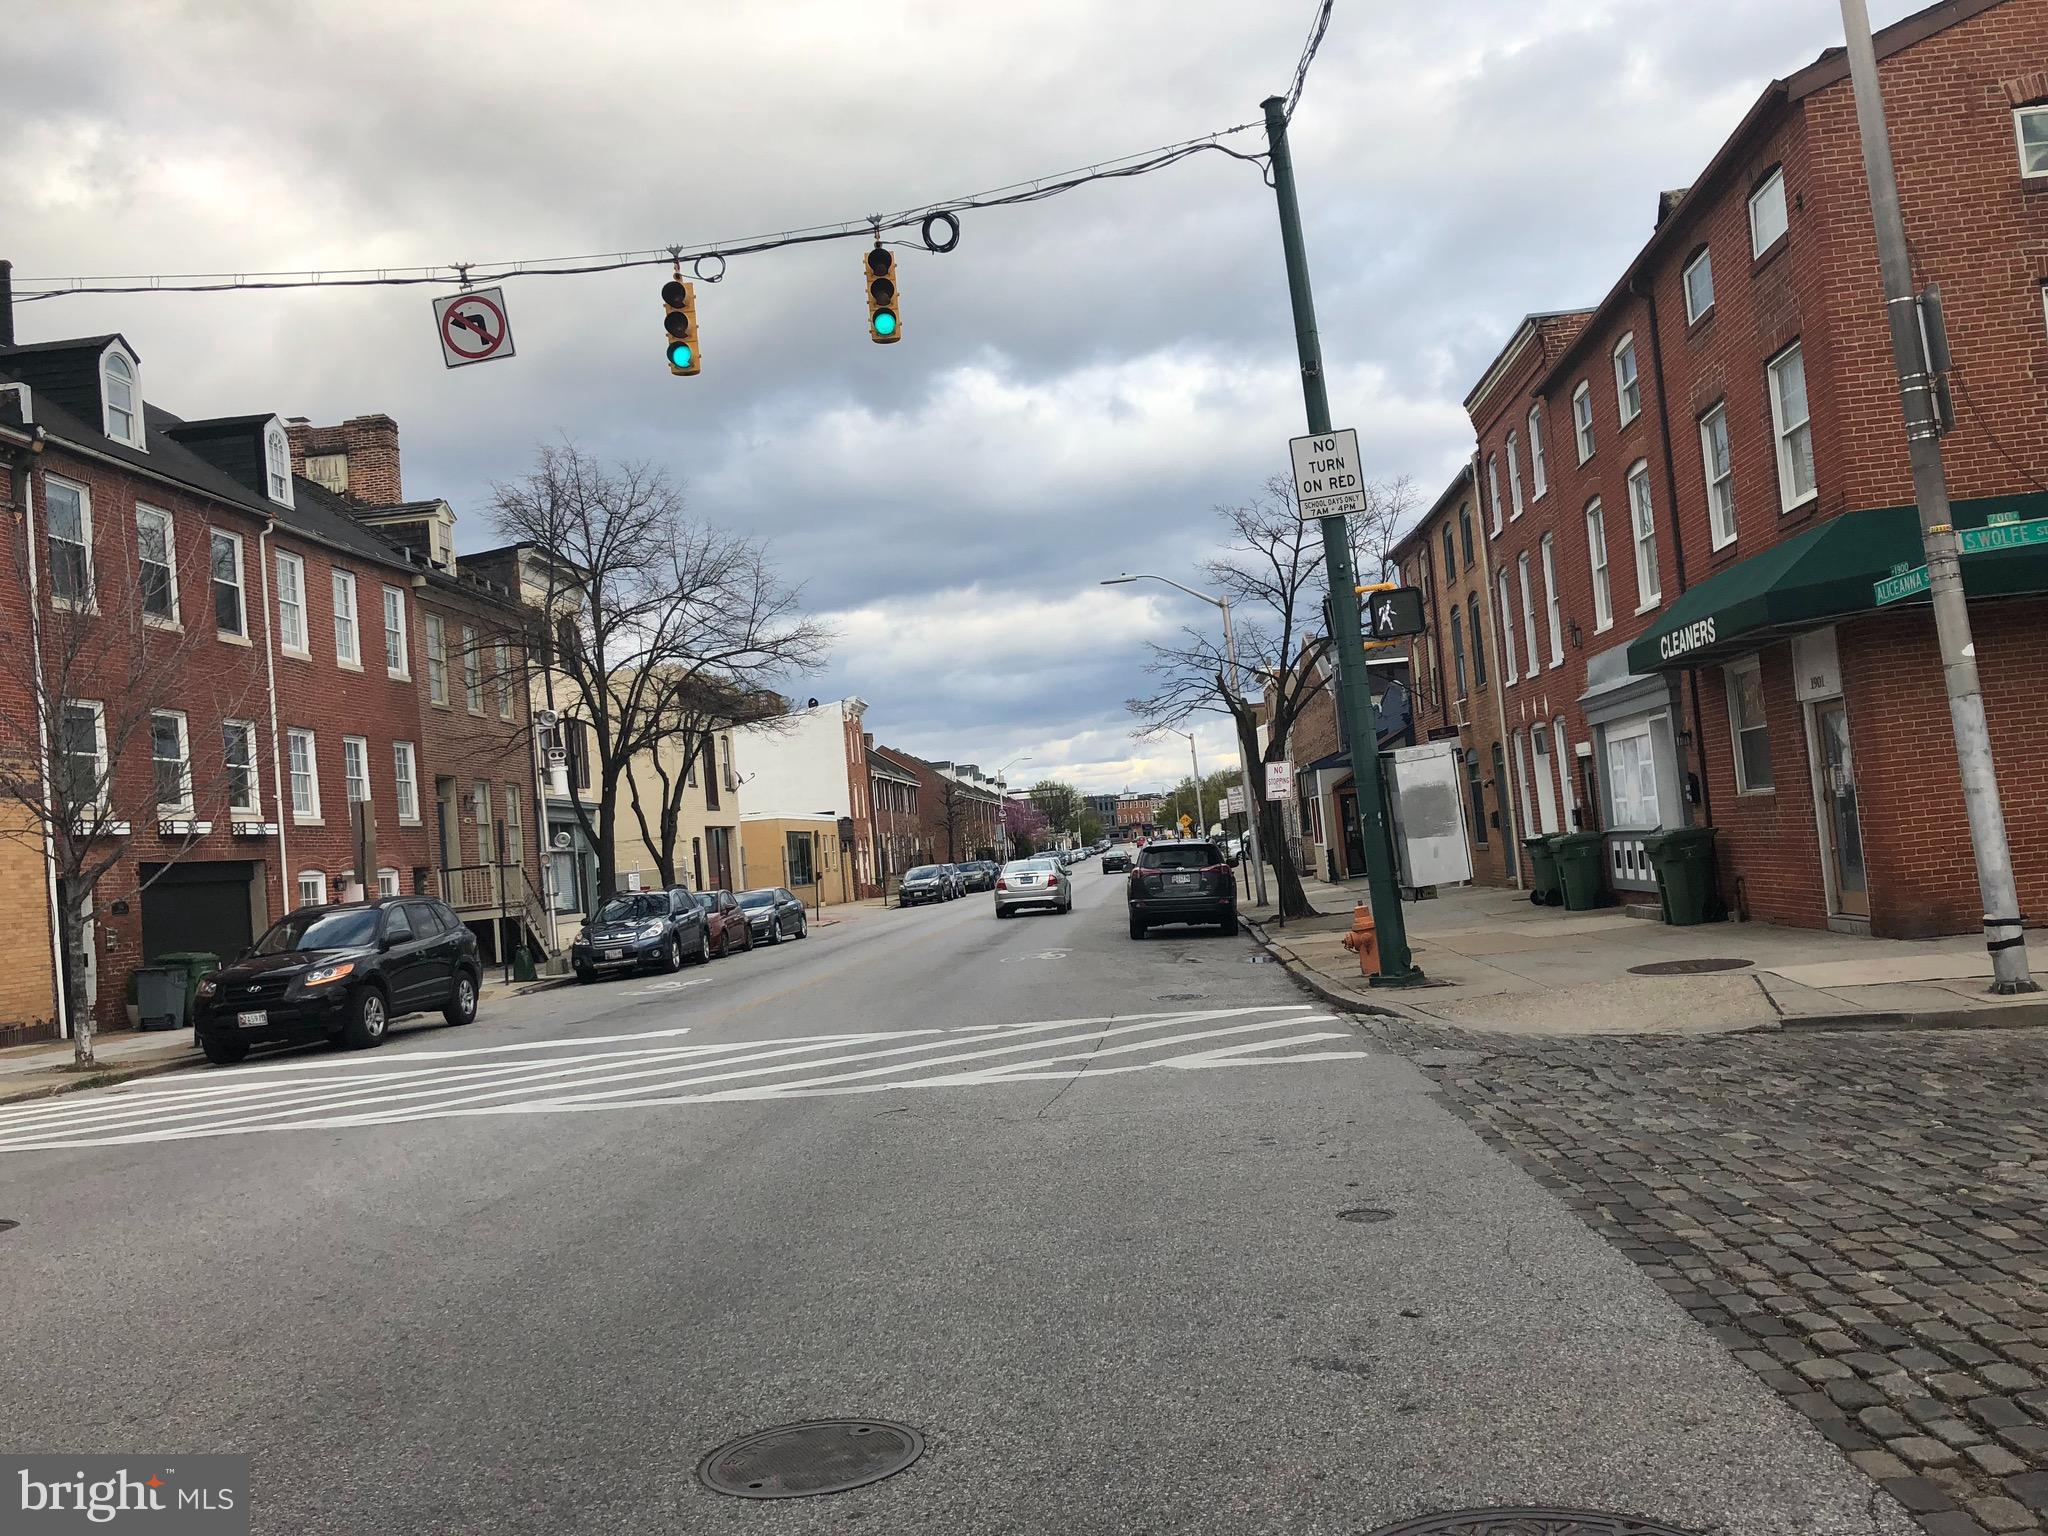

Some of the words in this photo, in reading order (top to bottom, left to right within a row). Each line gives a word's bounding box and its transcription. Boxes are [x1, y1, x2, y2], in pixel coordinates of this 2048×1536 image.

[1313, 439, 1335, 453] NO
[1309, 457, 1345, 473] TURN
[1303, 479, 1322, 493] ON
[1329, 474, 1355, 490] RED
[1304, 500, 1326, 509] SCHOOL
[1328, 497, 1344, 506] DAYS
[1345, 494, 1360, 503] ONLY
[1311, 507, 1329, 516] 7AM
[1338, 503, 1356, 512] 4PM
[1979, 525, 2030, 547] WOLFE
[1876, 572, 1923, 602] ALICEANNA
[1660, 616, 1716, 660] CLEANERS
[1810, 674, 1825, 689] 1901
[1273, 766, 1283, 774] NO
